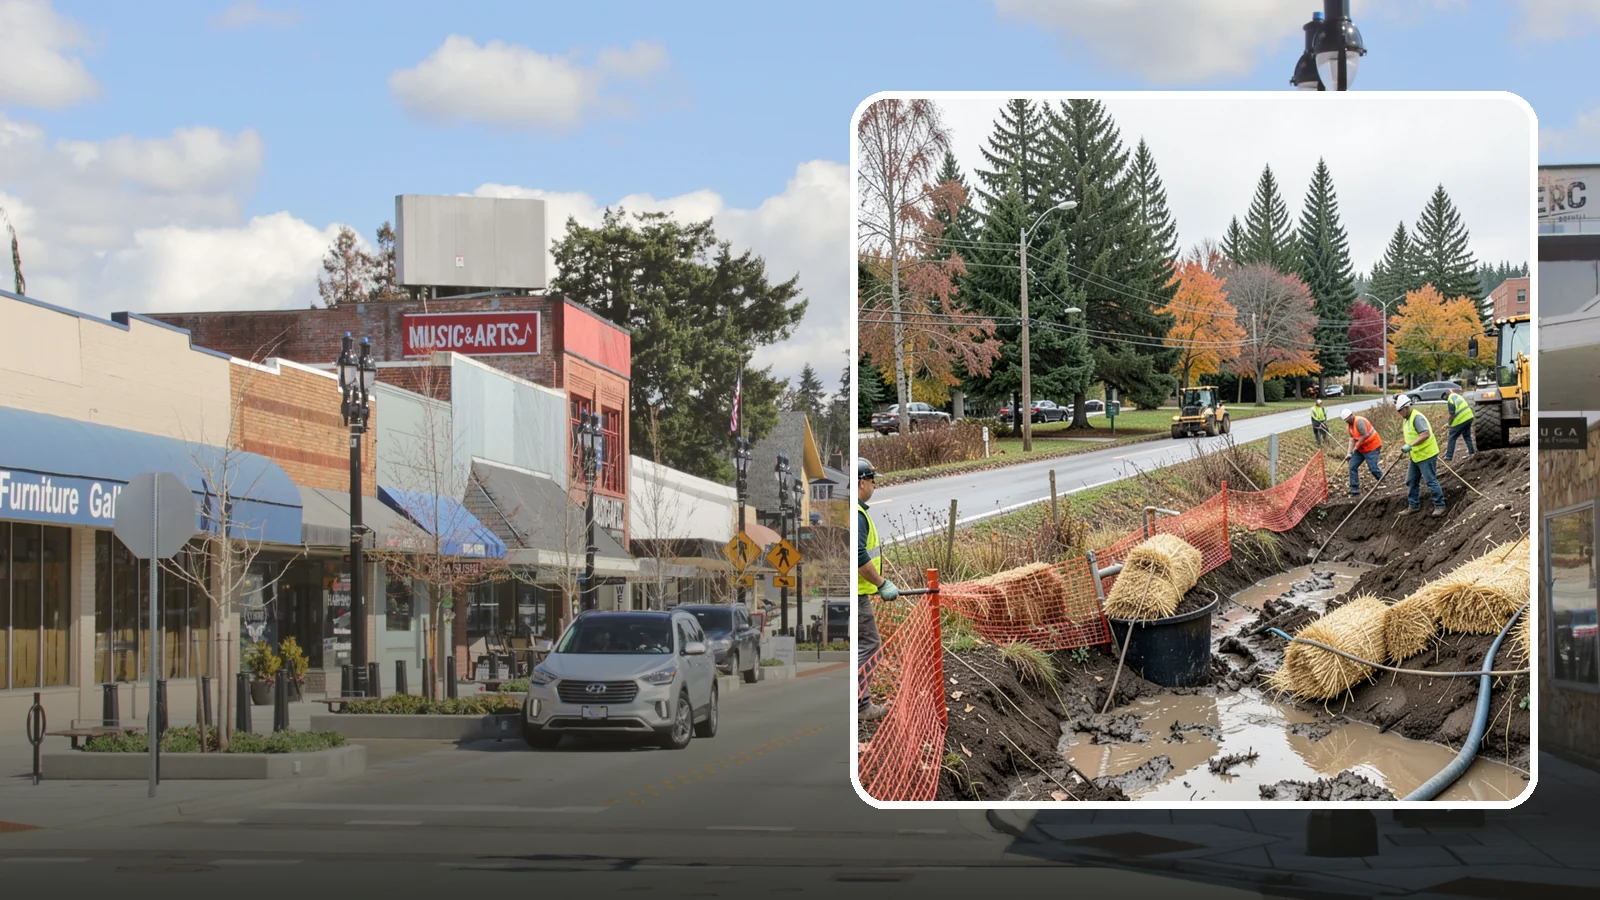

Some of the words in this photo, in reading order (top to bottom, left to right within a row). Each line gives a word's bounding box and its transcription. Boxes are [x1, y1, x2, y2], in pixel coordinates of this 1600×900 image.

[408, 322, 520, 349] MUSIC&ARTS
[0, 471, 80, 515] Furniture
[453, 563, 479, 574] SUSHI
